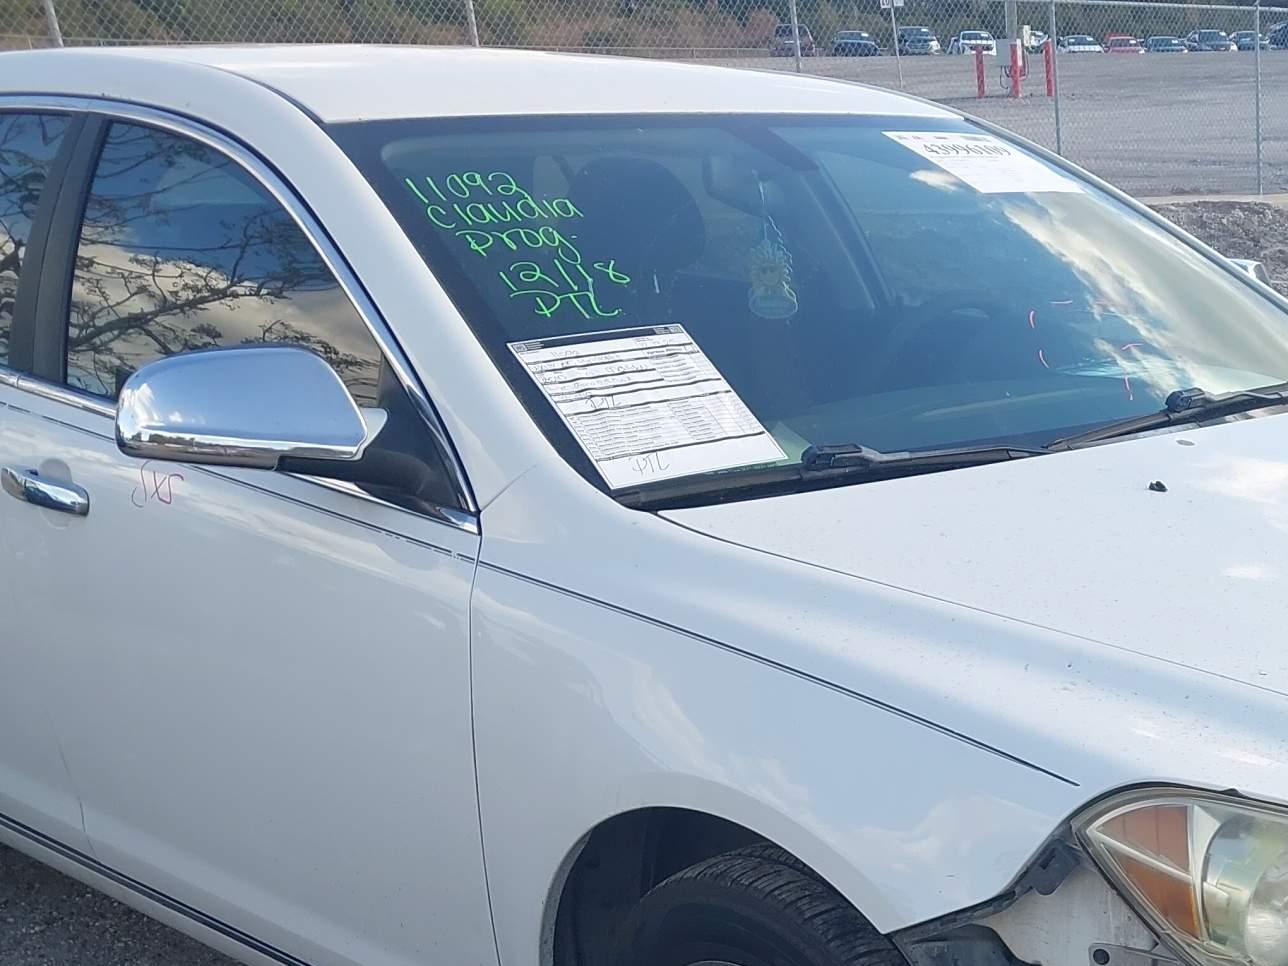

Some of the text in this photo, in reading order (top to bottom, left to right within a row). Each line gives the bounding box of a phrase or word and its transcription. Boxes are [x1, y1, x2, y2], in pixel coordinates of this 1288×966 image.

[922, 143, 1012, 156] 43996109
[405, 171, 531, 204] 11092
[426, 197, 584, 229] Claudia
